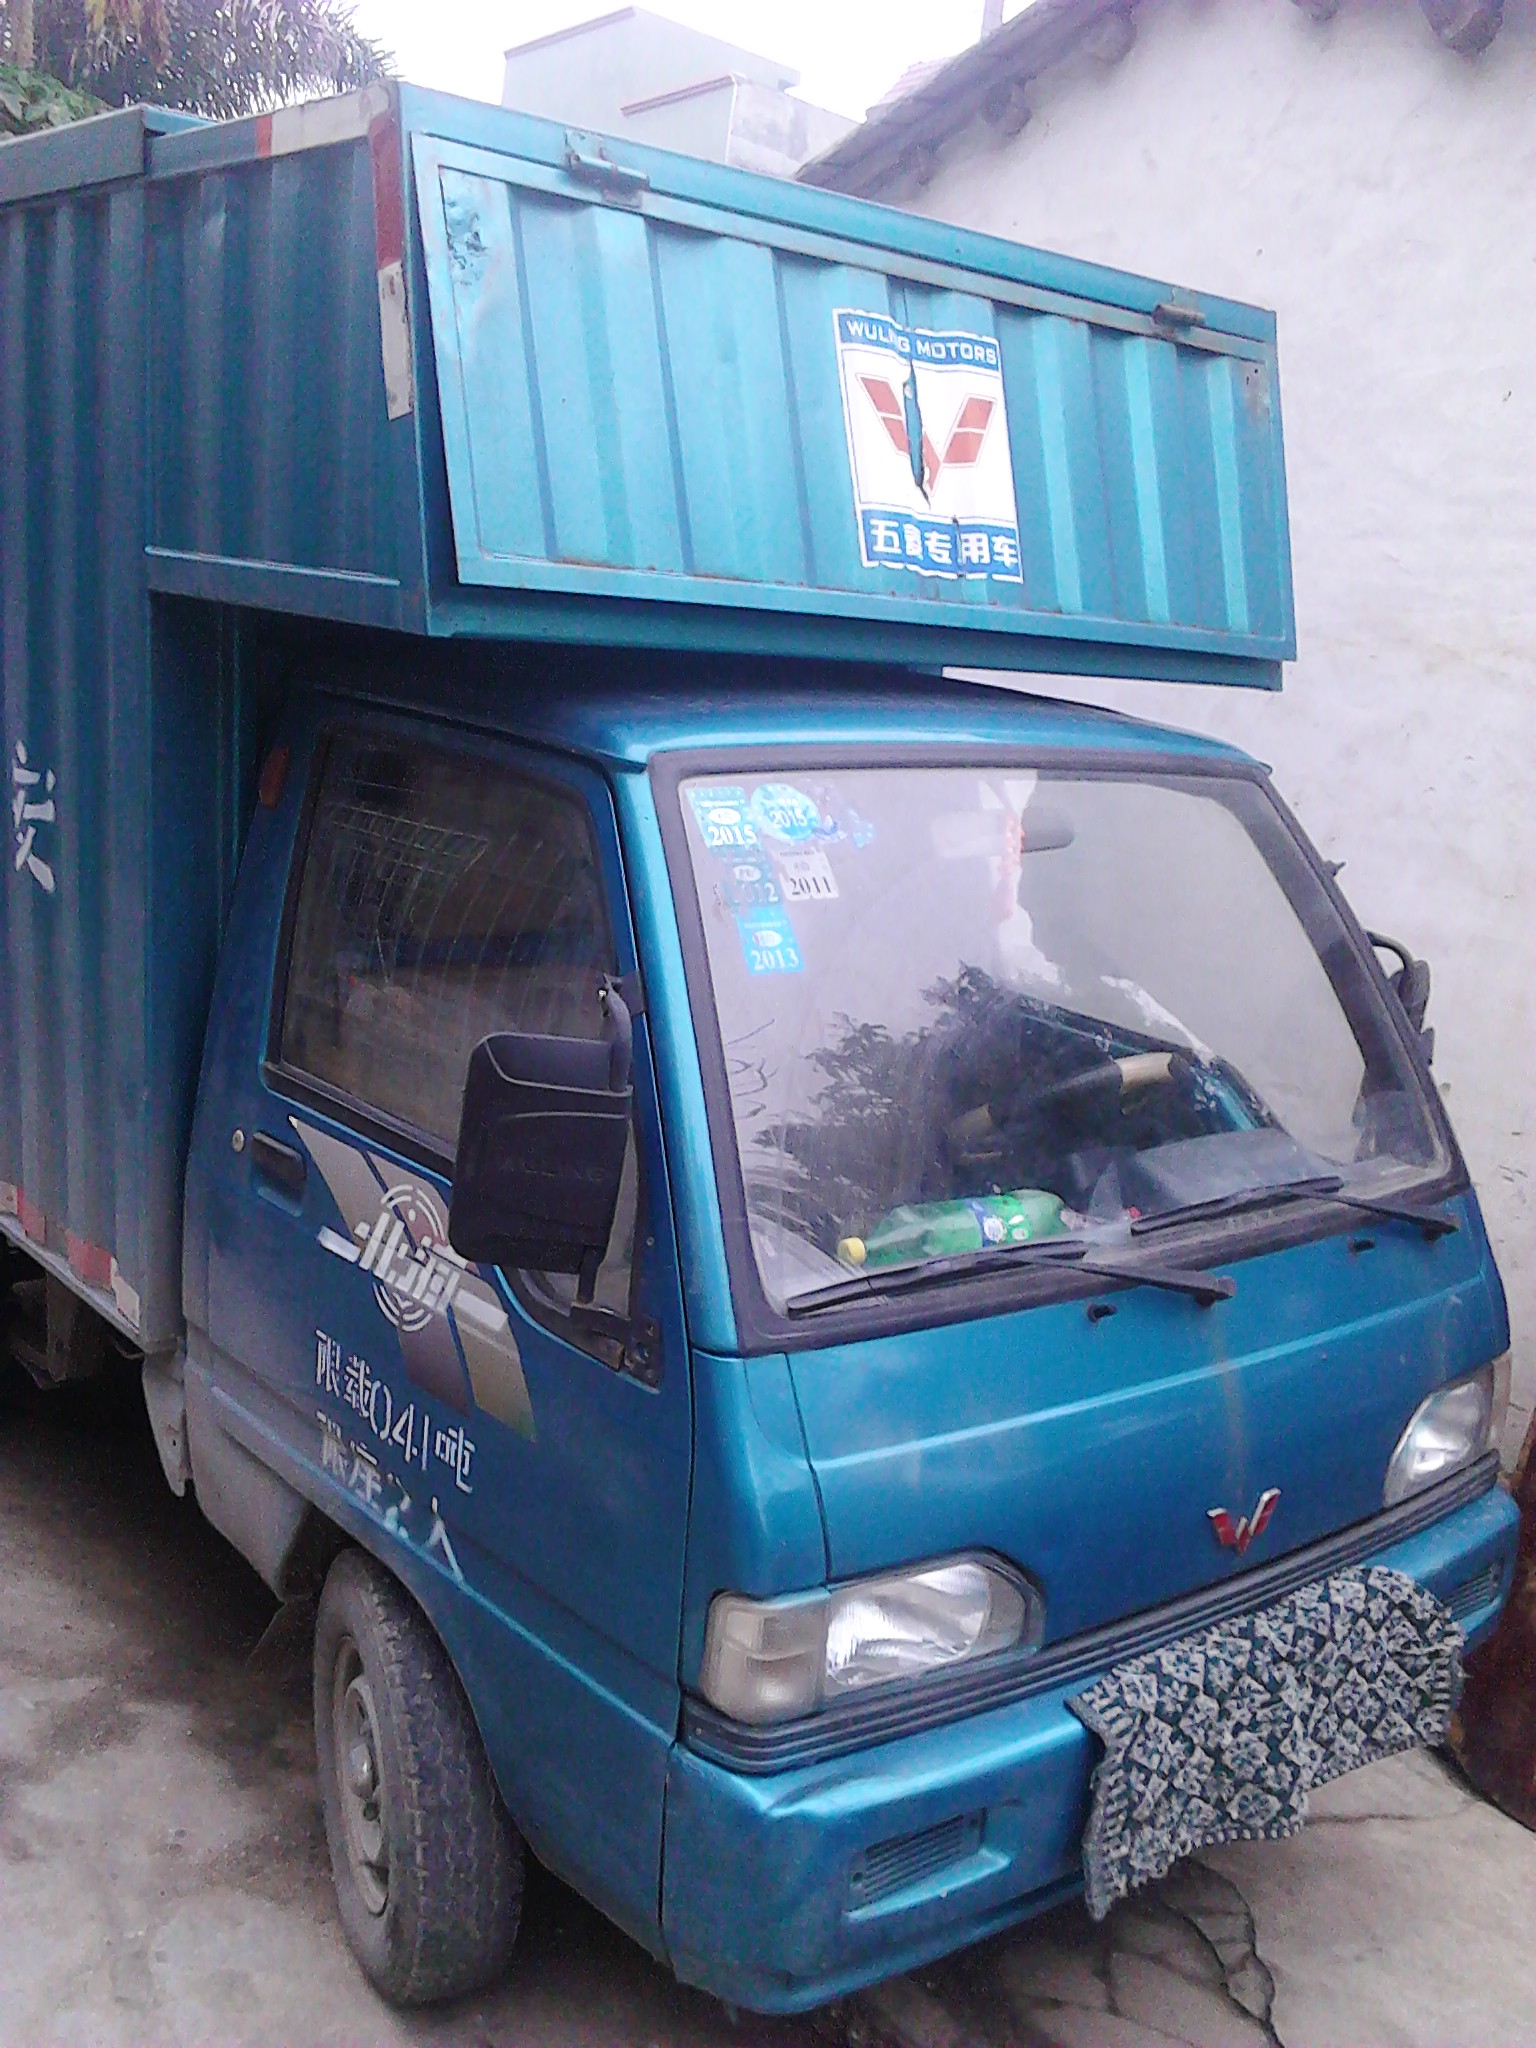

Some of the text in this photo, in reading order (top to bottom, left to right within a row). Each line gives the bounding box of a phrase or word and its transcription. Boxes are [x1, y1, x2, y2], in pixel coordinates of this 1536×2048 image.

[916, 340, 998, 365] MOTORS
[769, 808, 808, 830] 2015
[708, 824, 757, 847] 2015
[789, 875, 832, 896] 2011
[751, 947, 799, 971] 2013
